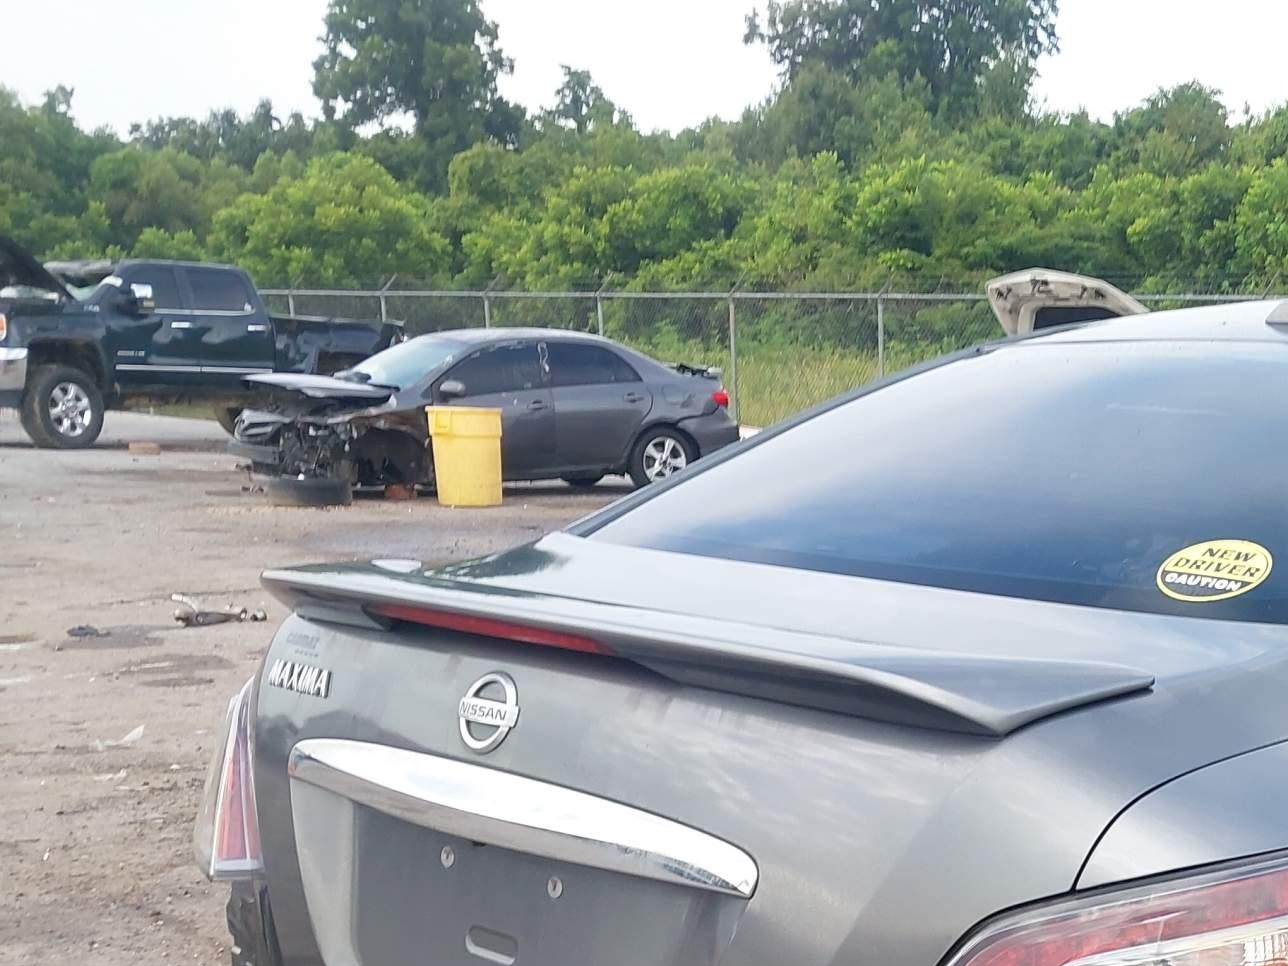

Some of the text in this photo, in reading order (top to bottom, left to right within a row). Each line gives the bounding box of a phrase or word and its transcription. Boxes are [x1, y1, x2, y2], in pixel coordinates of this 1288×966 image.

[1201, 547, 1257, 562] NEW
[1173, 557, 1261, 577] DRIVER
[1164, 572, 1241, 591] CAUTION
[268, 659, 331, 698] MAXIMA
[460, 701, 508, 721] NISSAN
